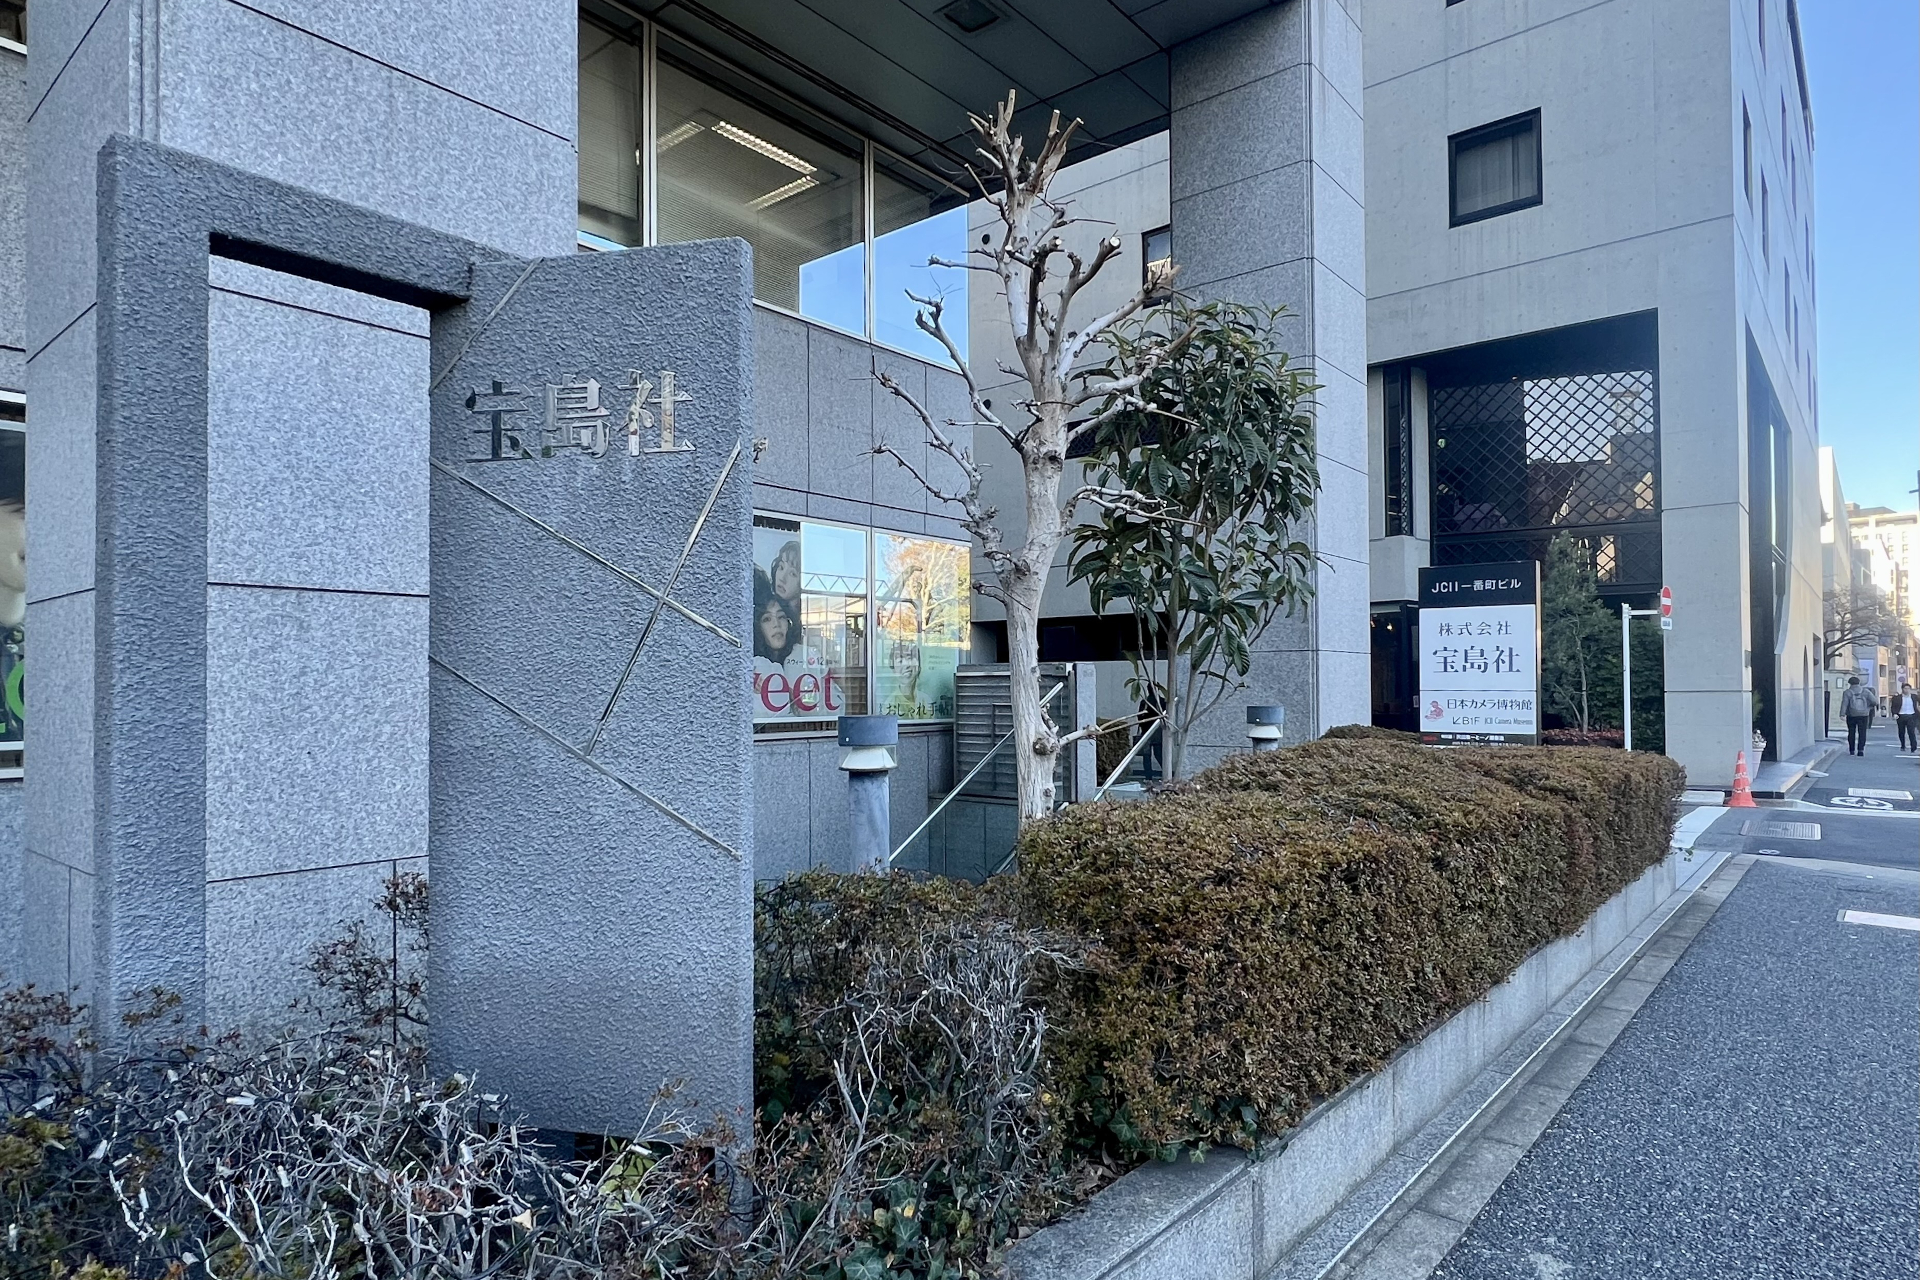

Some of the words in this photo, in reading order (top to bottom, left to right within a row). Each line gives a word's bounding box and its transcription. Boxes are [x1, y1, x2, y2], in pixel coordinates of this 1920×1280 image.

[465, 368, 696, 463] 宝島社
[1438, 620, 1513, 637] 株式会社
[1432, 645, 1522, 674] 宝島社
[1447, 698, 1533, 711] 日本カメラ博物館
[1462, 716, 1480, 725] B1F
